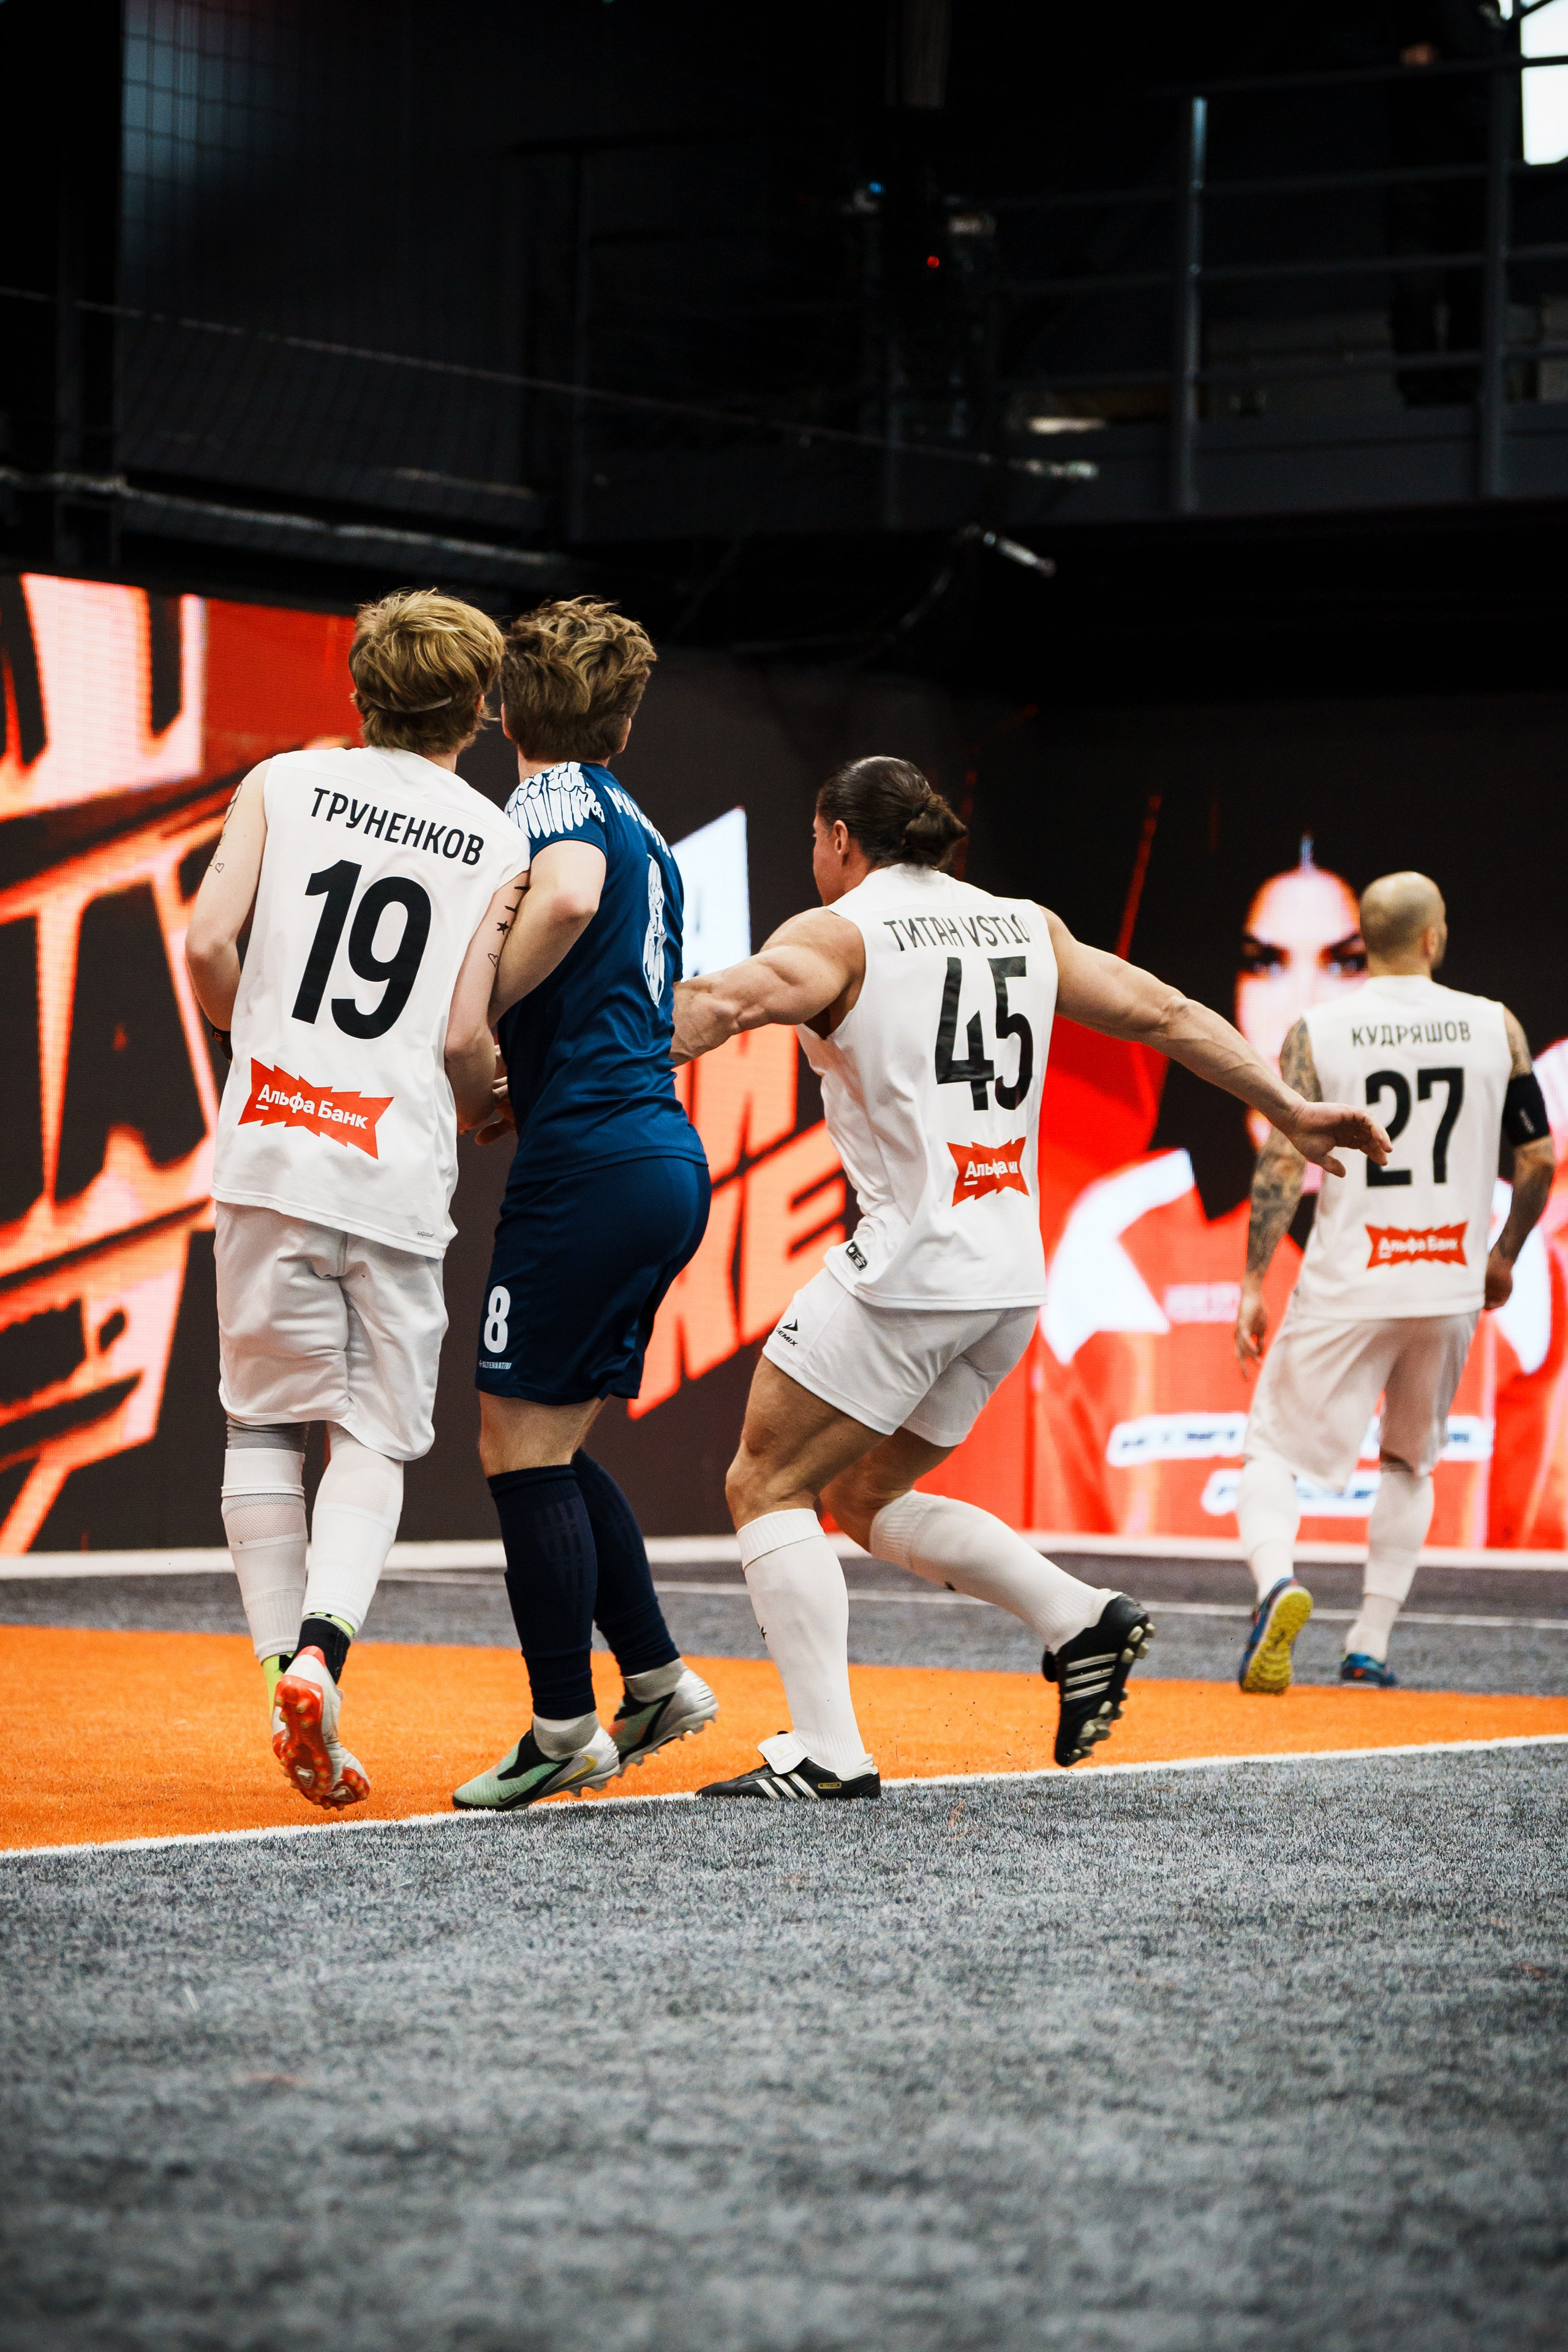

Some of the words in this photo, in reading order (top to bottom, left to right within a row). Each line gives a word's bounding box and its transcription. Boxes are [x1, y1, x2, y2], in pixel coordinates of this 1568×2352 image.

[311, 787, 484, 866] ТРУНЕНКОВ
[291, 859, 432, 1040] 19
[883, 916, 965, 951] ТИТАН
[935, 956, 1034, 1111] 45
[1351, 1020, 1471, 1046] КУДРЯШОВ
[257, 1084, 315, 1114] Альфа
[317, 1099, 369, 1129] Банк
[1365, 1066, 1464, 1187] 27
[484, 1286, 511, 1353] 8
